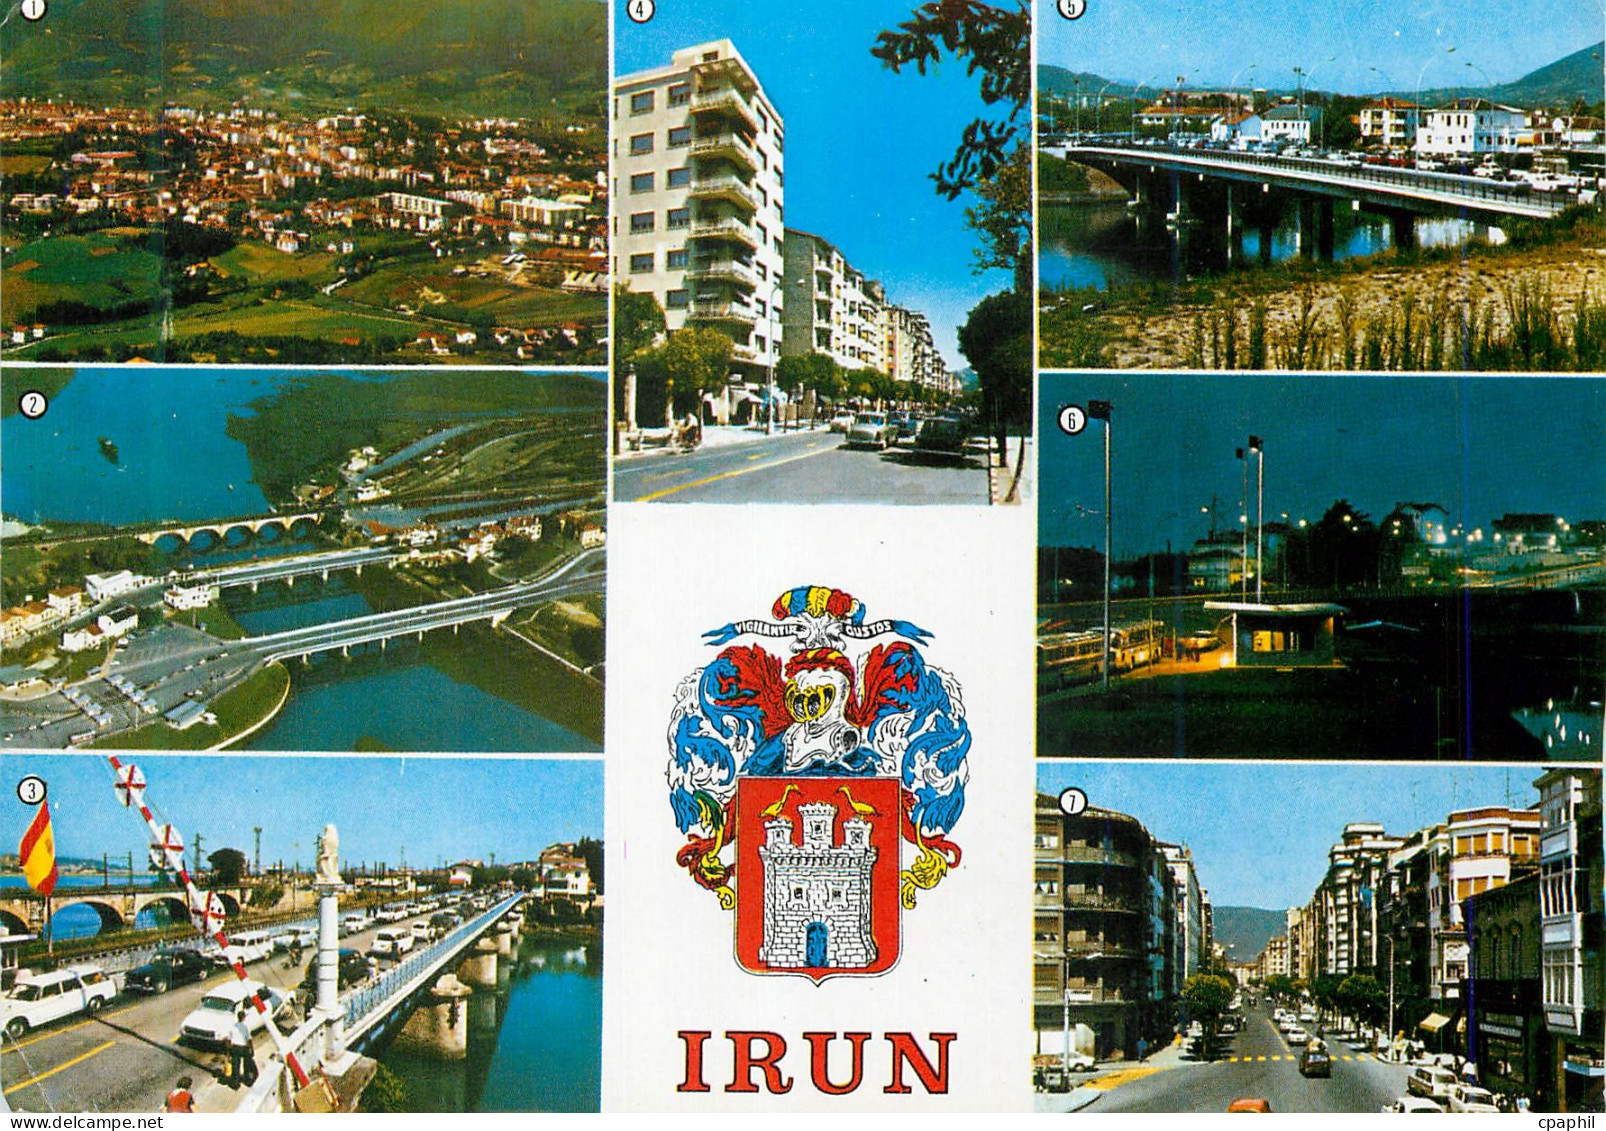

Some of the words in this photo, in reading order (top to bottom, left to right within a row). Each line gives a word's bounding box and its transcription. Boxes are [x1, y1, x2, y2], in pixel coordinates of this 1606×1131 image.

[636, 1, 643, 17] 4
[1068, 0, 1075, 15] 5
[30, 396, 37, 413] 2
[1068, 412, 1076, 430] 6
[28, 782, 36, 799] 3
[1069, 794, 1076, 811] 7
[676, 1030, 958, 1095] IRUN
